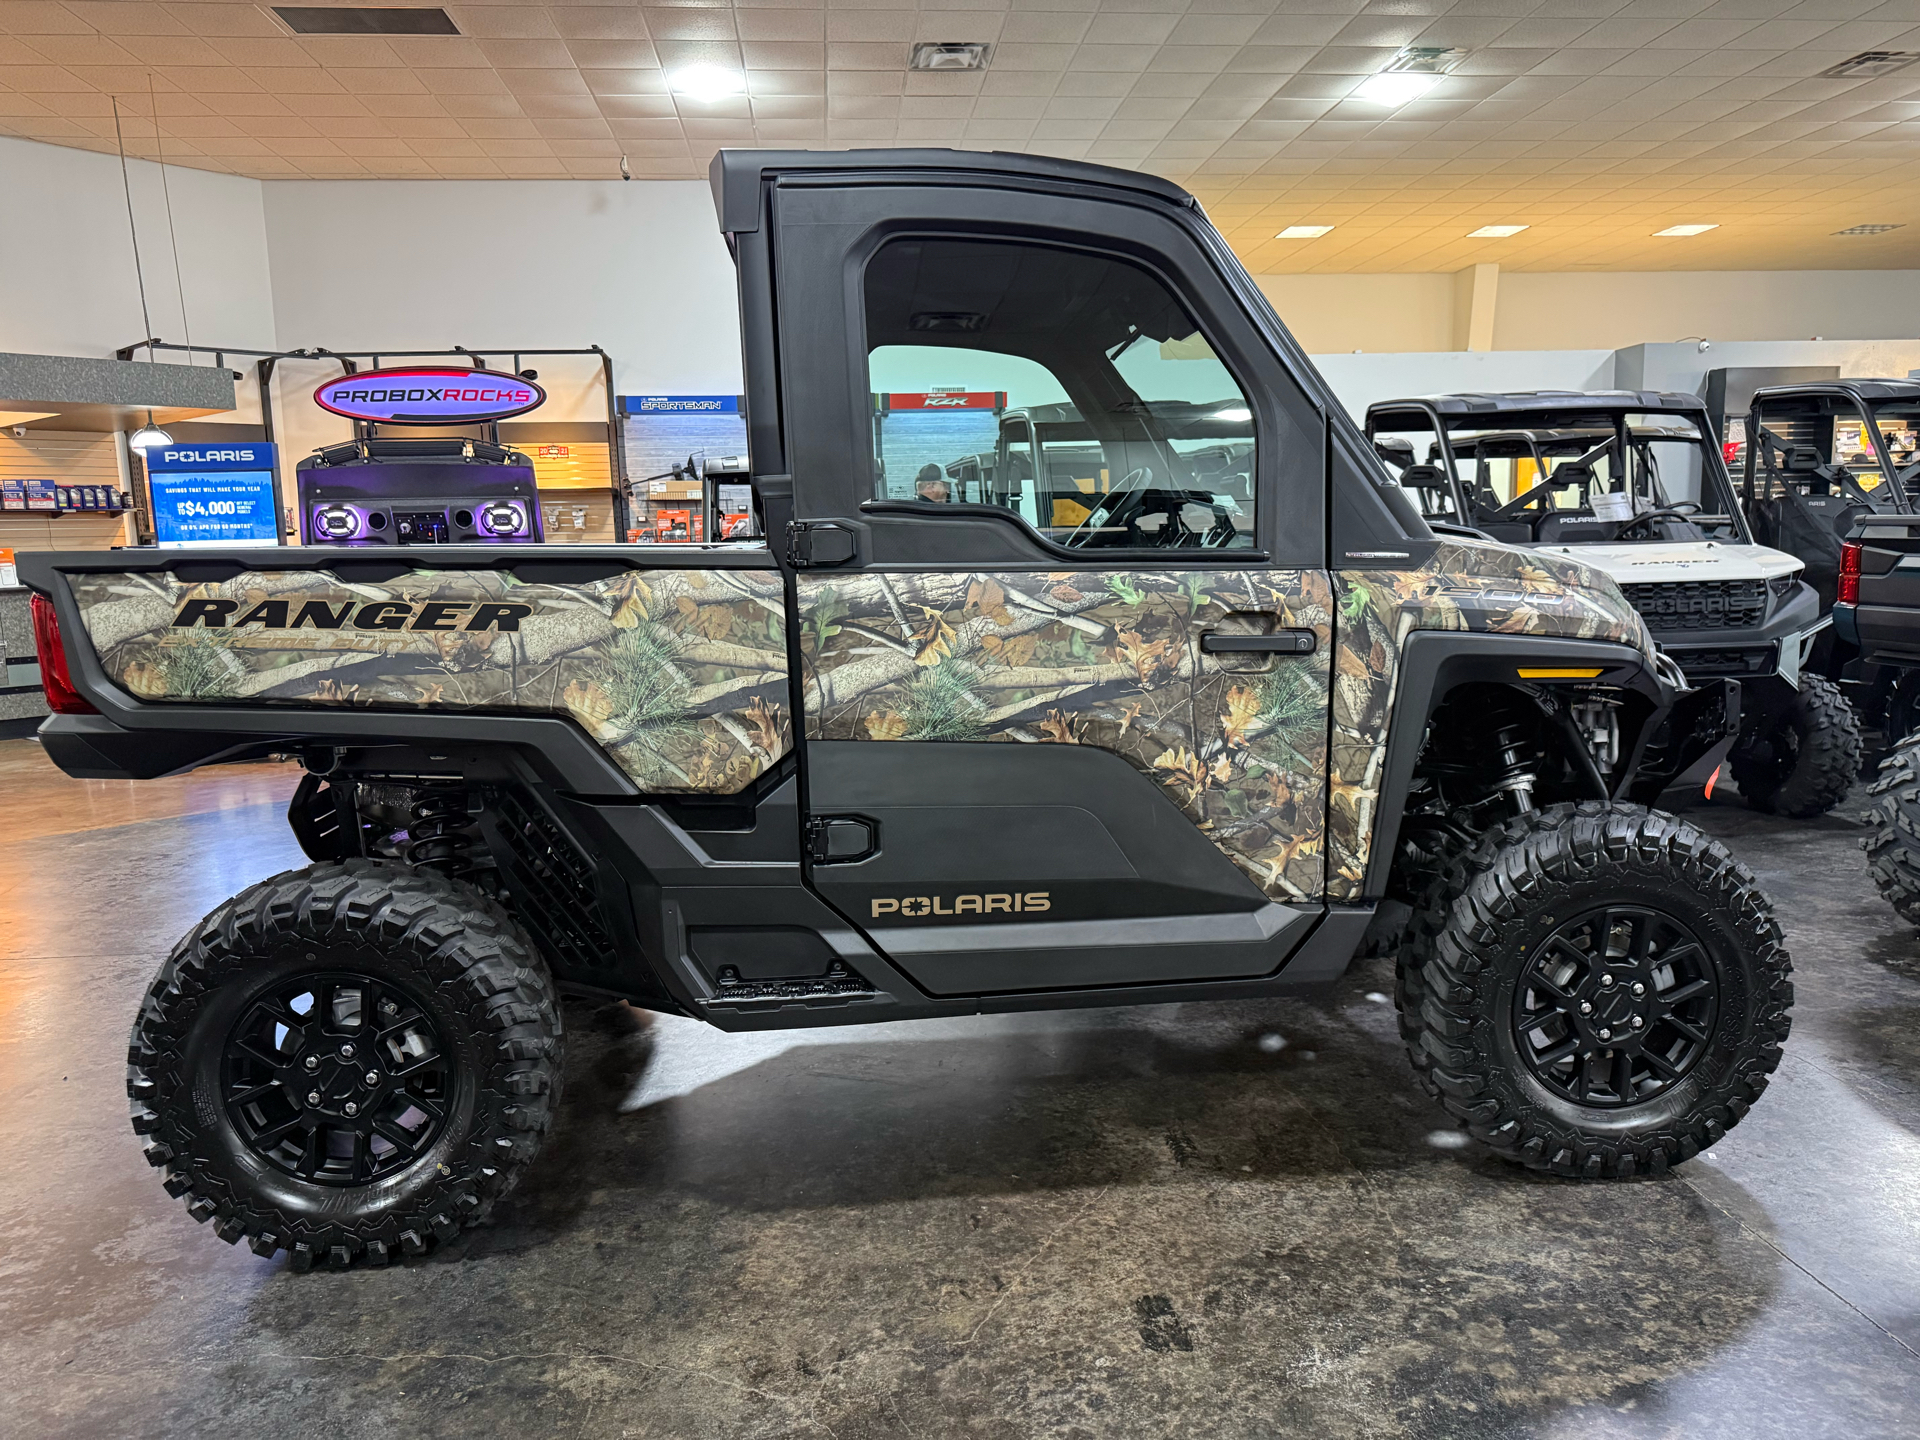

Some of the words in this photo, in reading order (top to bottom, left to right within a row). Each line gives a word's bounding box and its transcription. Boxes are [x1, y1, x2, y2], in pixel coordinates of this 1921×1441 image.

[332, 388, 531, 403] PROBOXROCKS
[641, 401, 722, 411] SPORTSMAN
[164, 450, 255, 463] POLARIS
[1424, 585, 1564, 605] 1500
[1638, 597, 1750, 613] POLARIS
[169, 598, 534, 632] RANGER
[157, 635, 320, 649] EXTREME
[329, 638, 419, 650] DUTY
[871, 892, 1051, 918] POLARIS
